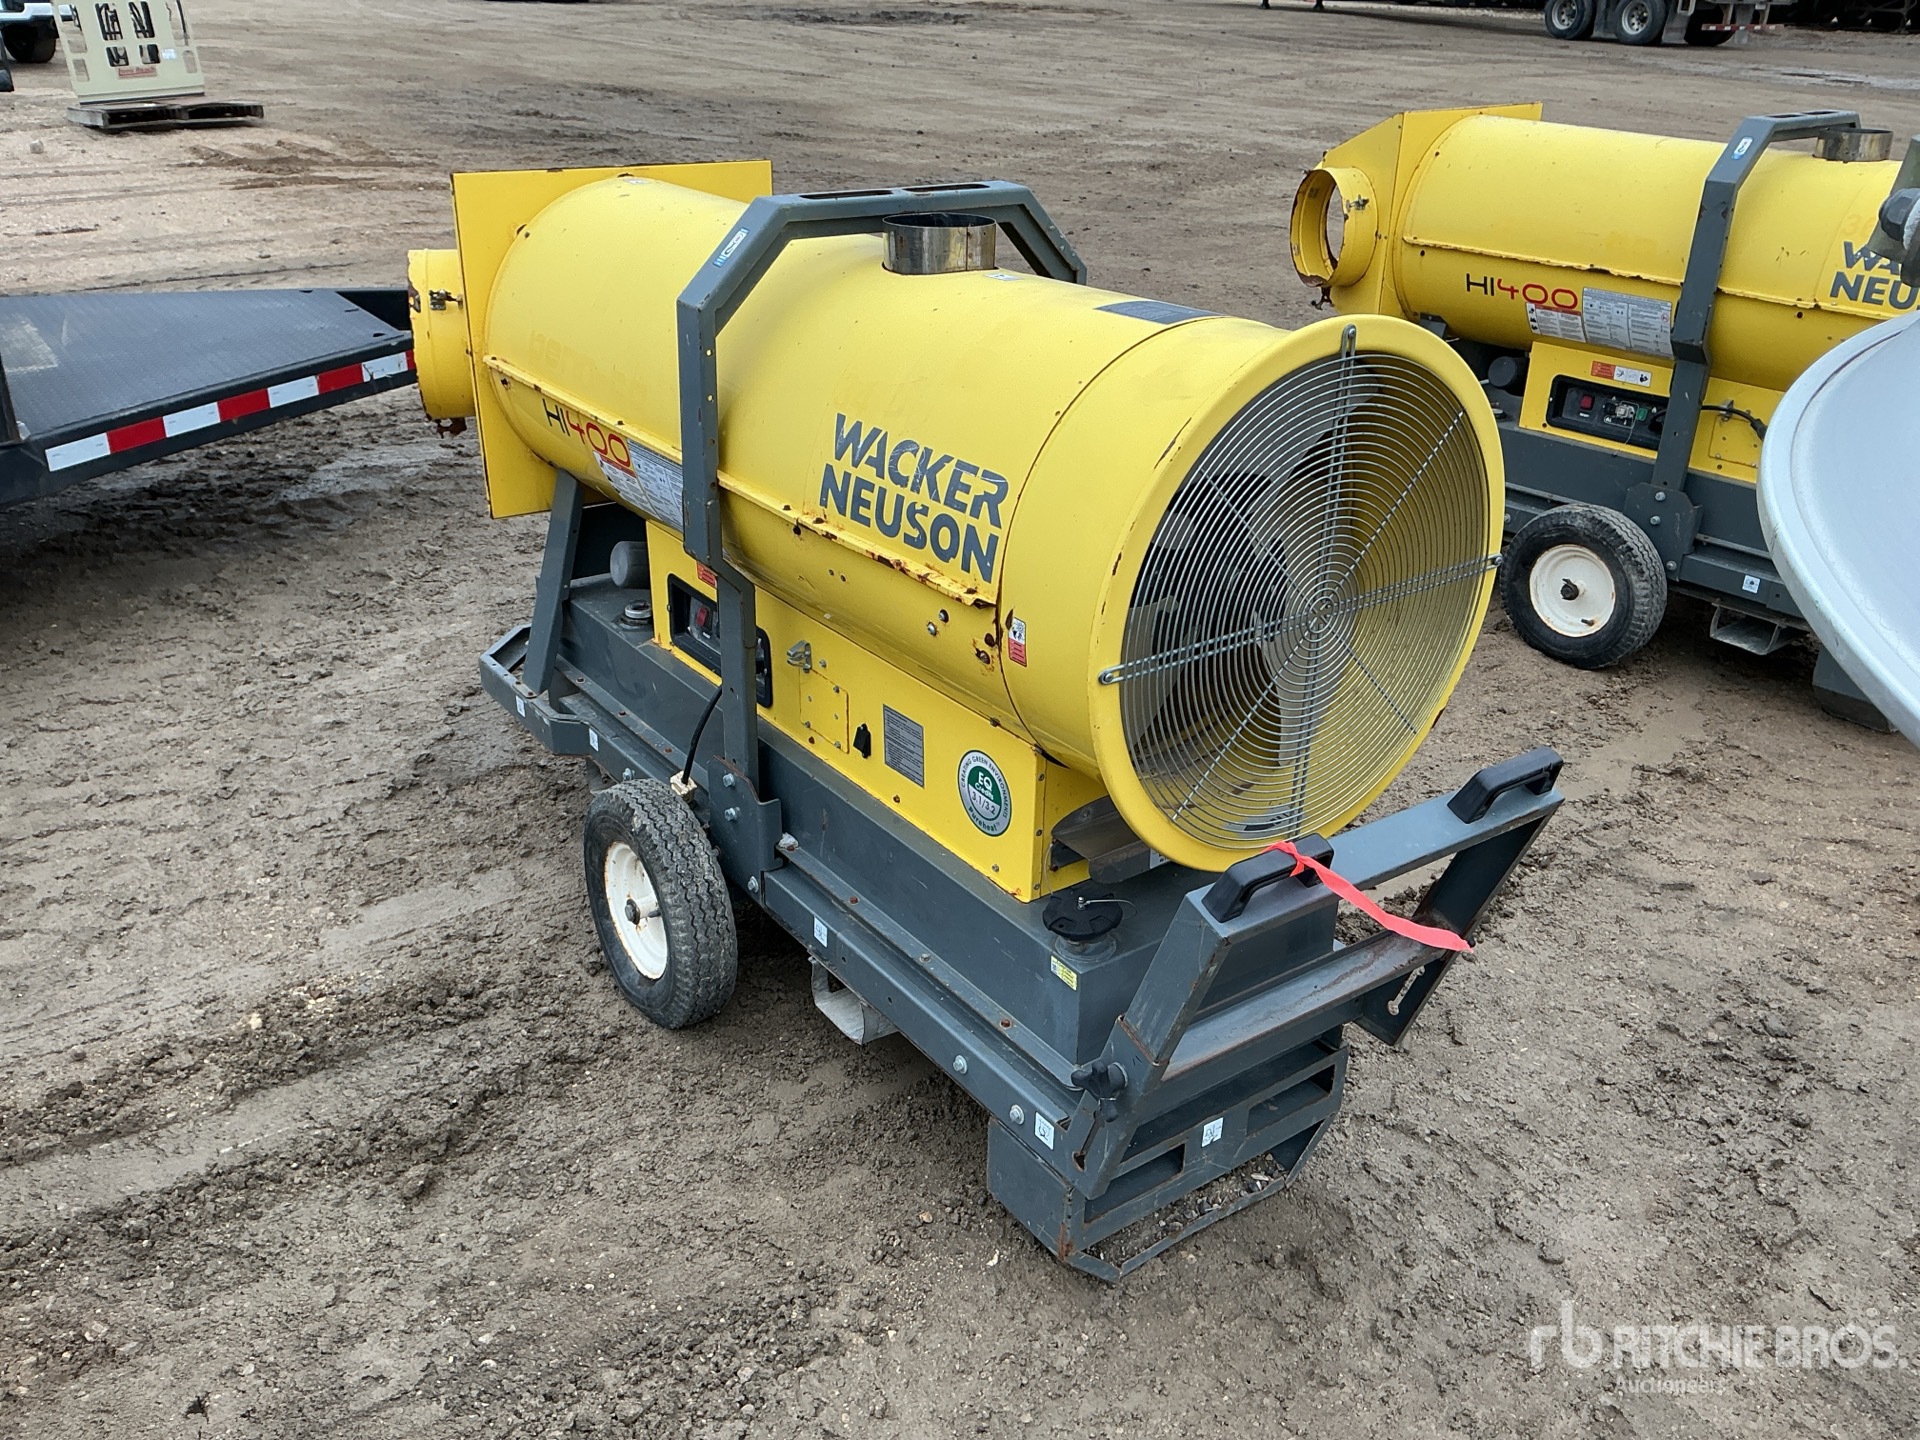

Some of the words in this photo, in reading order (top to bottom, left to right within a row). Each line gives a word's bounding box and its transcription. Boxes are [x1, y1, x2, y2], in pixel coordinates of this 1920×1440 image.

[1466, 273, 1578, 310] HI400
[542, 398, 631, 468] HI400
[834, 412, 1009, 529] WACKER
[819, 463, 999, 584] NEUSON
[972, 756, 988, 766] GREEN
[978, 772, 992, 791] EQ
[971, 791, 996, 815] 3.1/3.2
